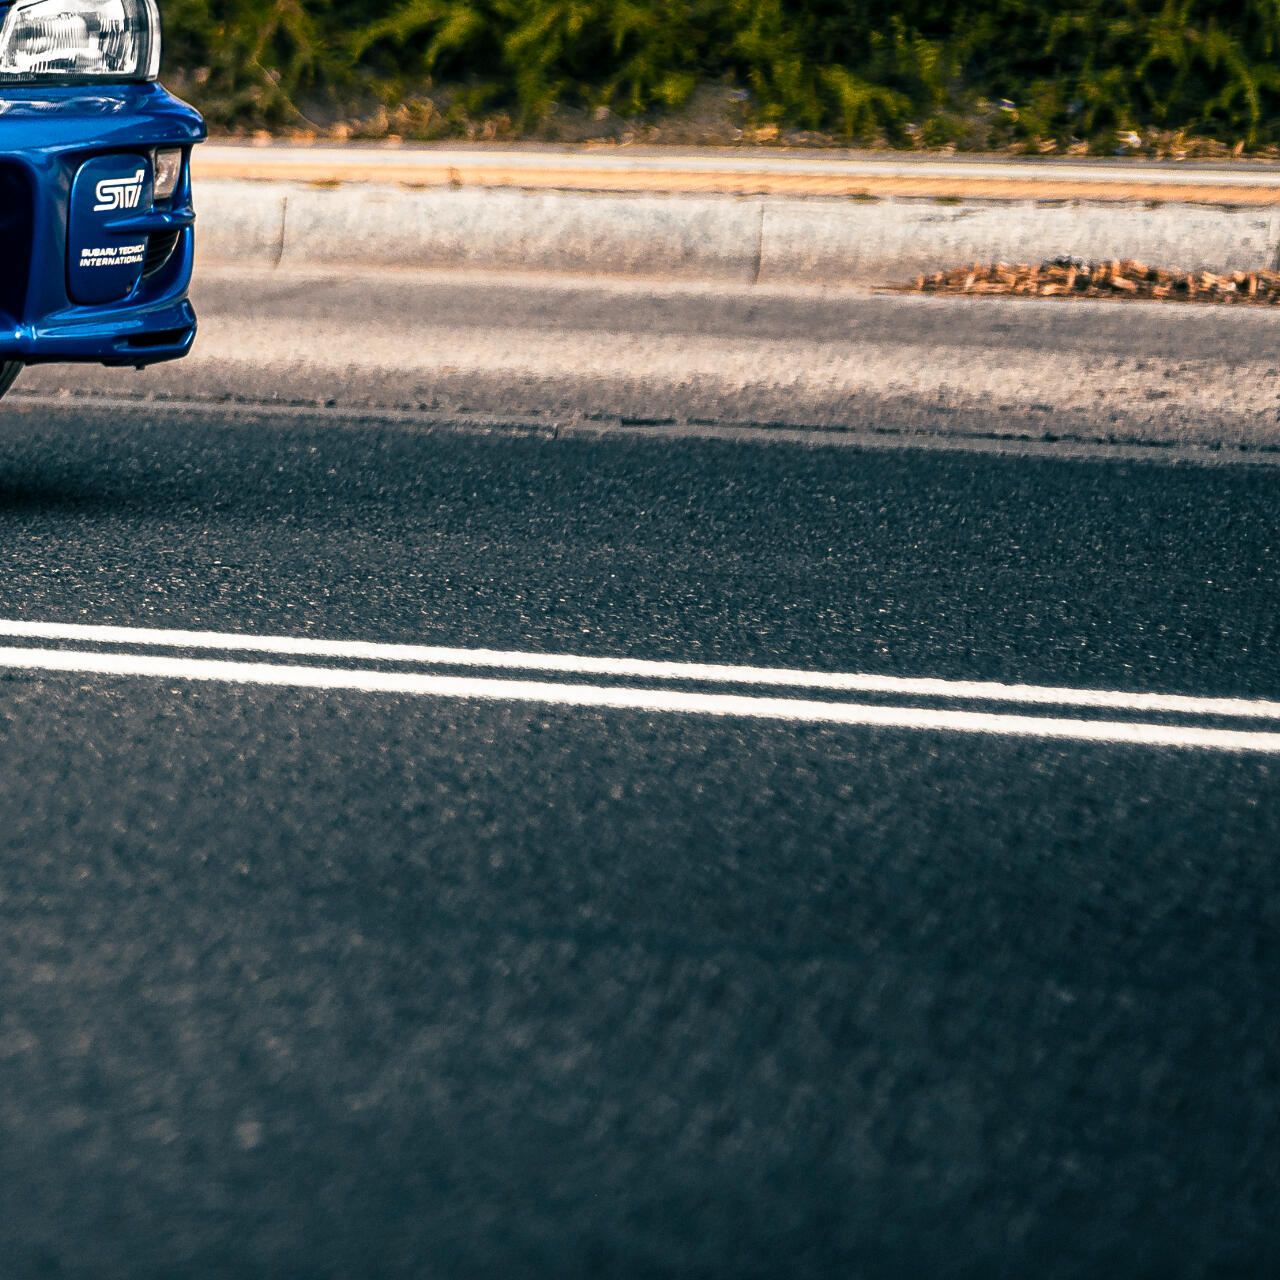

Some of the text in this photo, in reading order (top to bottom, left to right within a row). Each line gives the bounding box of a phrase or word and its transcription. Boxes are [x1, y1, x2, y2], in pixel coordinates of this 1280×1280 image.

[81, 244, 145, 257] SUBARU TECNICA
[79, 254, 143, 267] INTERNATIONAL
